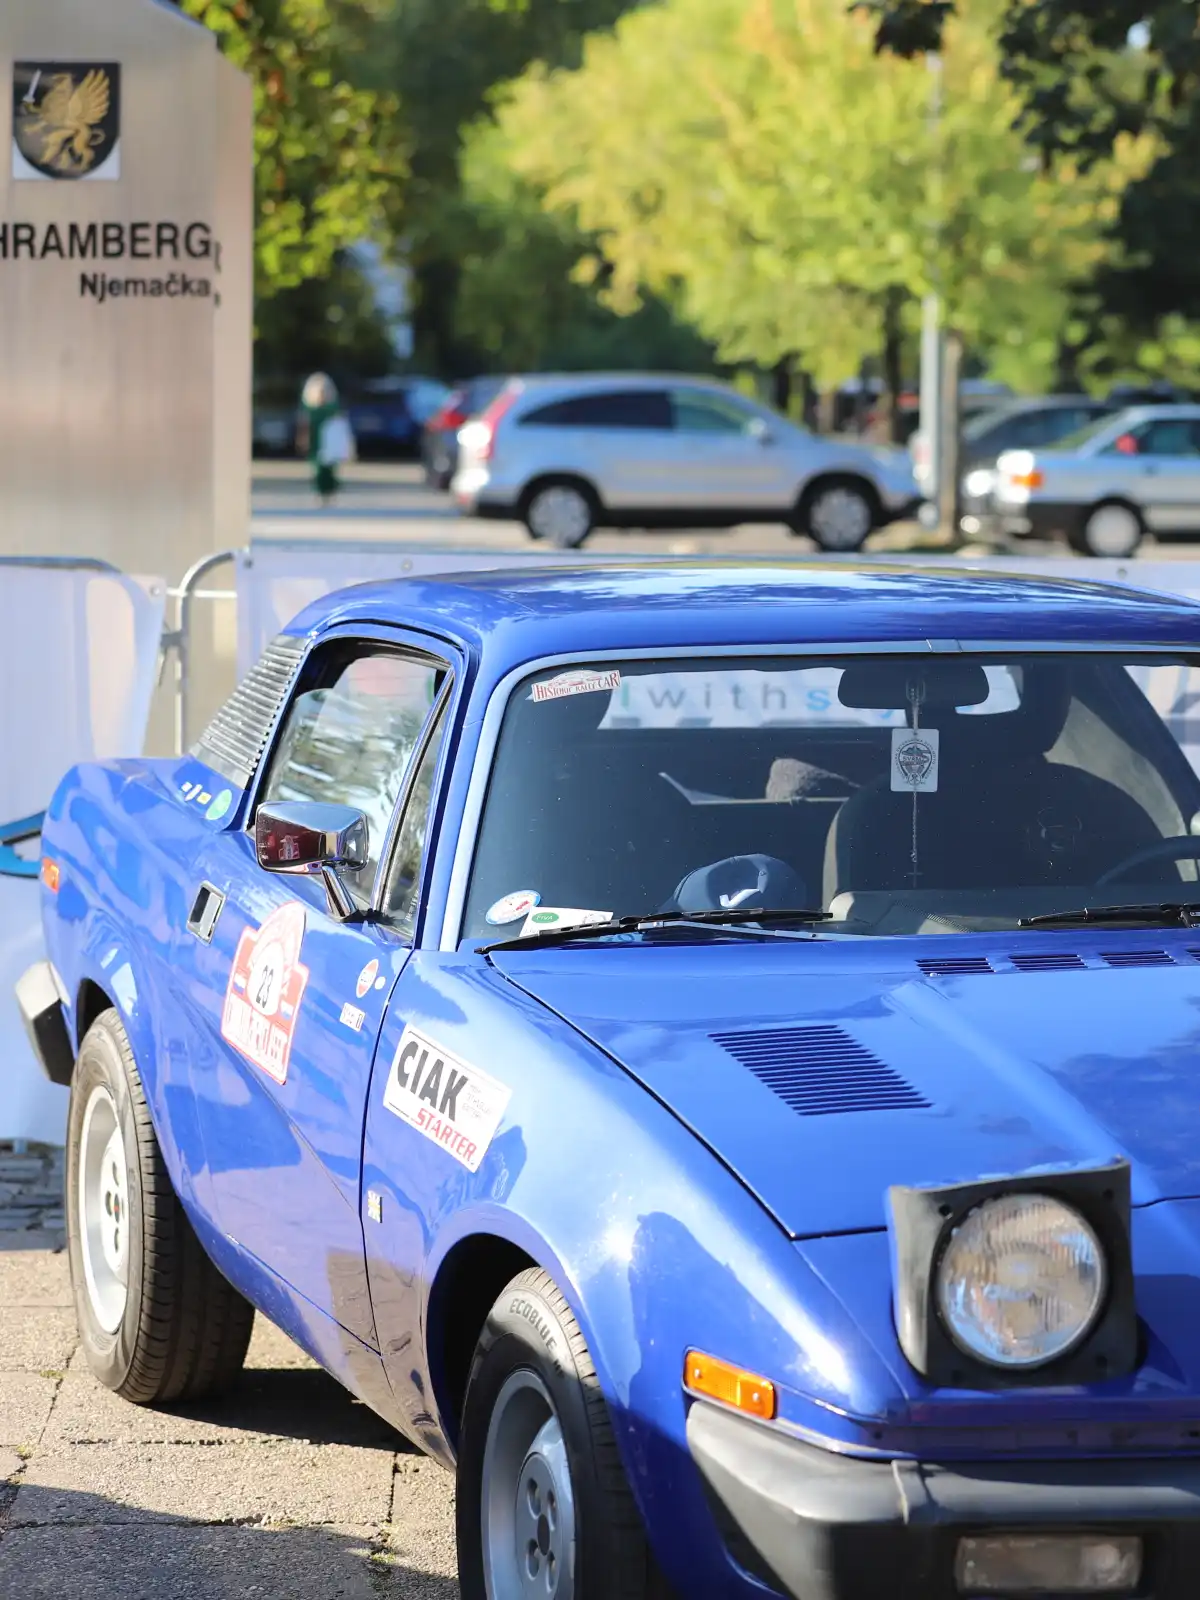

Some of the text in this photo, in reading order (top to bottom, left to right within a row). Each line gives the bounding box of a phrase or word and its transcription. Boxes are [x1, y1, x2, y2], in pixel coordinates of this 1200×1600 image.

[80, 271, 211, 304] Njemačka
[534, 684, 573, 700] HISTORIC
[598, 671, 618, 690] CAR
[254, 965, 275, 1009] 23
[397, 1040, 469, 1122] CIAK
[414, 1107, 478, 1162] STARTER
[509, 1299, 558, 1352] ECOBLUE
